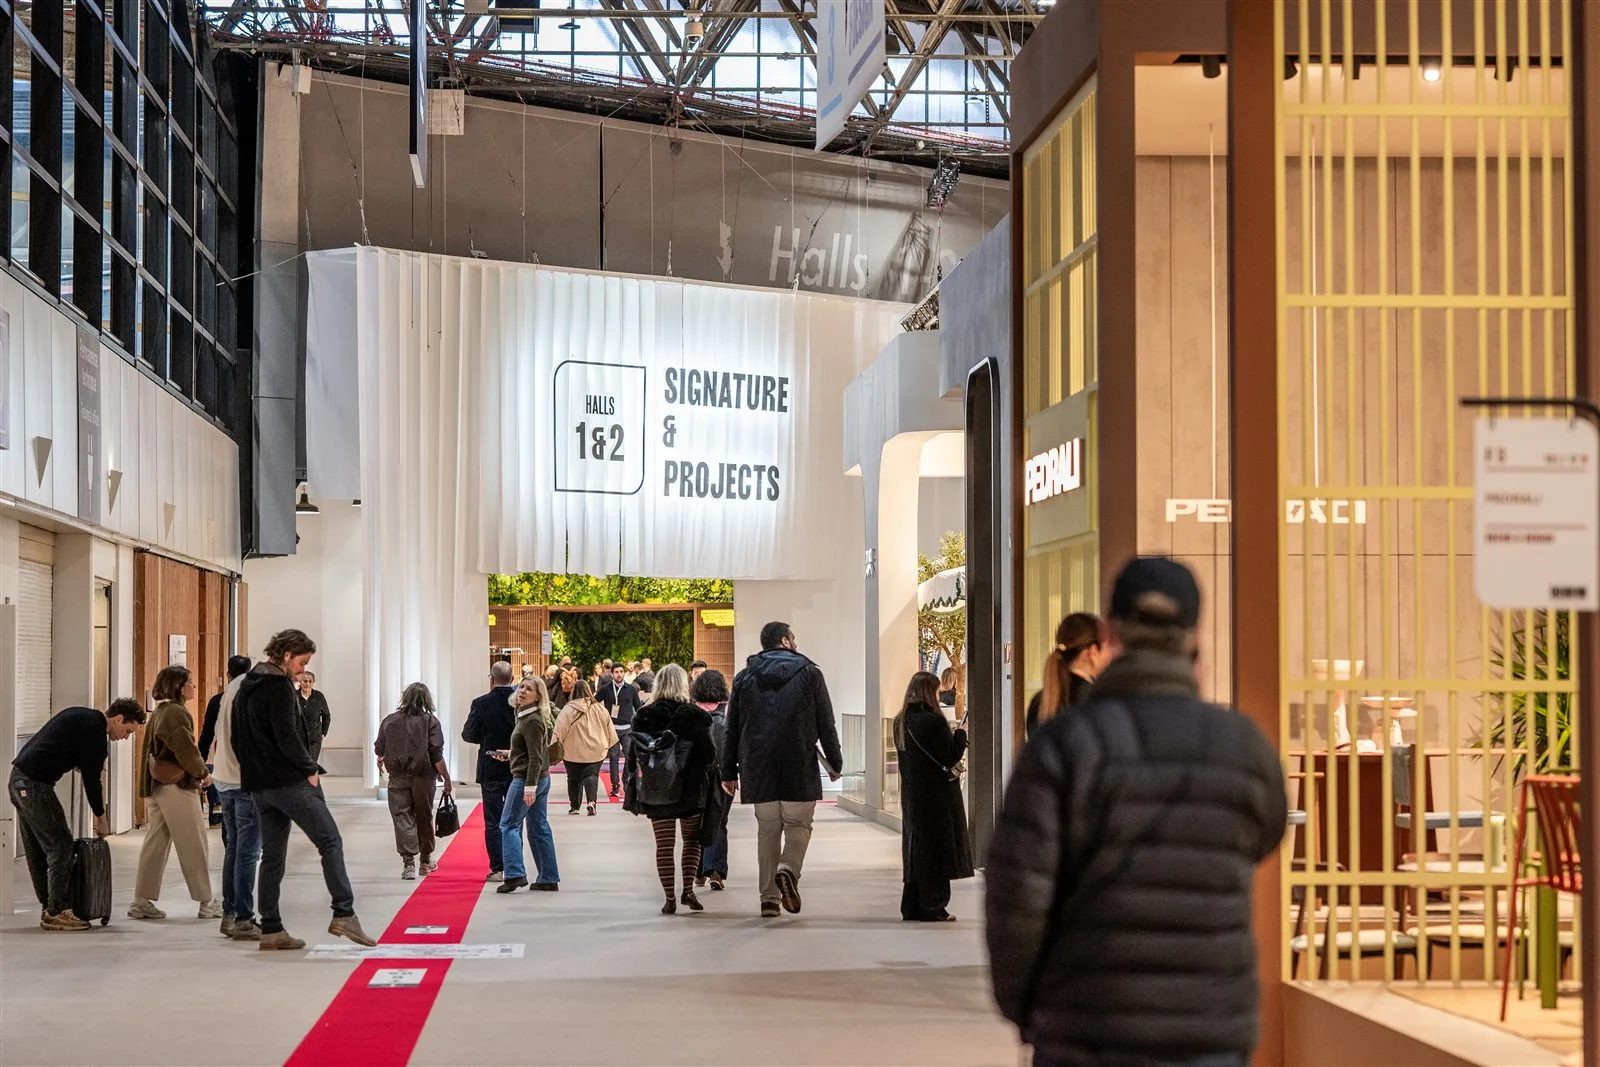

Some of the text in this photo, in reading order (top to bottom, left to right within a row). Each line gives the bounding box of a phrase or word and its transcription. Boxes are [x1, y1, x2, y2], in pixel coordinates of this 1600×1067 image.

[769, 225, 867, 291] Halls
[585, 394, 615, 416] HALLS
[664, 366, 789, 413] SIGNATURE
[575, 421, 625, 462] 1&2
[662, 414, 677, 448] &
[663, 459, 780, 502] PROJECTS
[1024, 437, 1080, 506] PEDRALI
